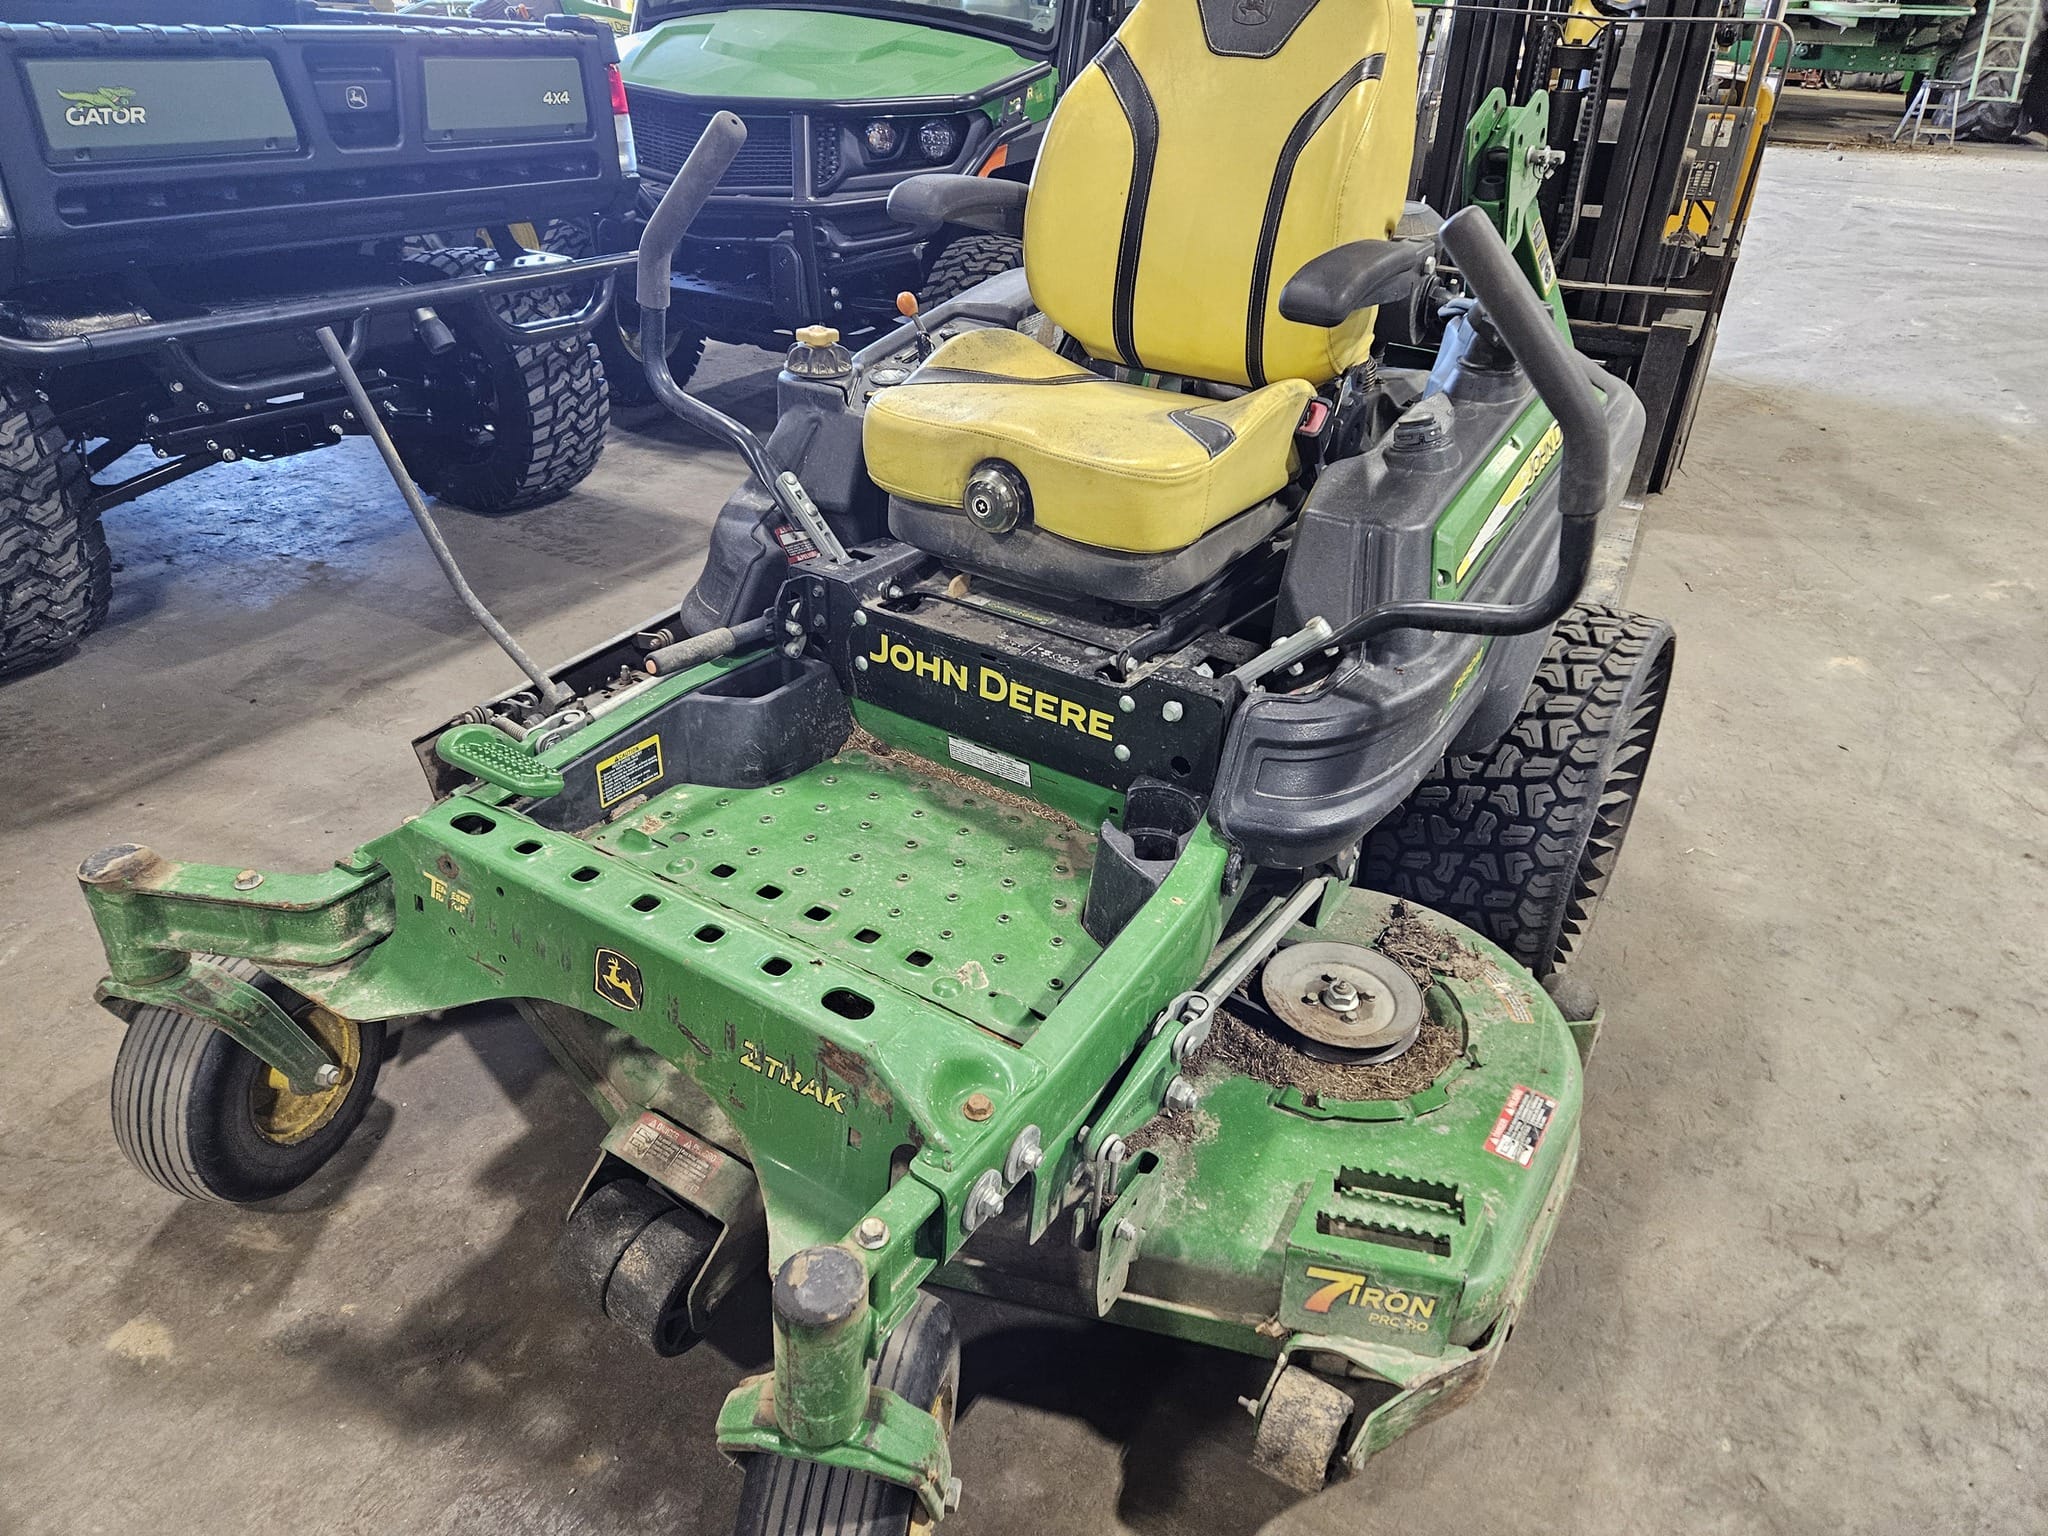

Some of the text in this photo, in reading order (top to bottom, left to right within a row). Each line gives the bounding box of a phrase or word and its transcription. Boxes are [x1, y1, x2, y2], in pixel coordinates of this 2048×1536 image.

[65, 106, 146, 126] GATOR
[869, 634, 1115, 742] JOHN DEERE
